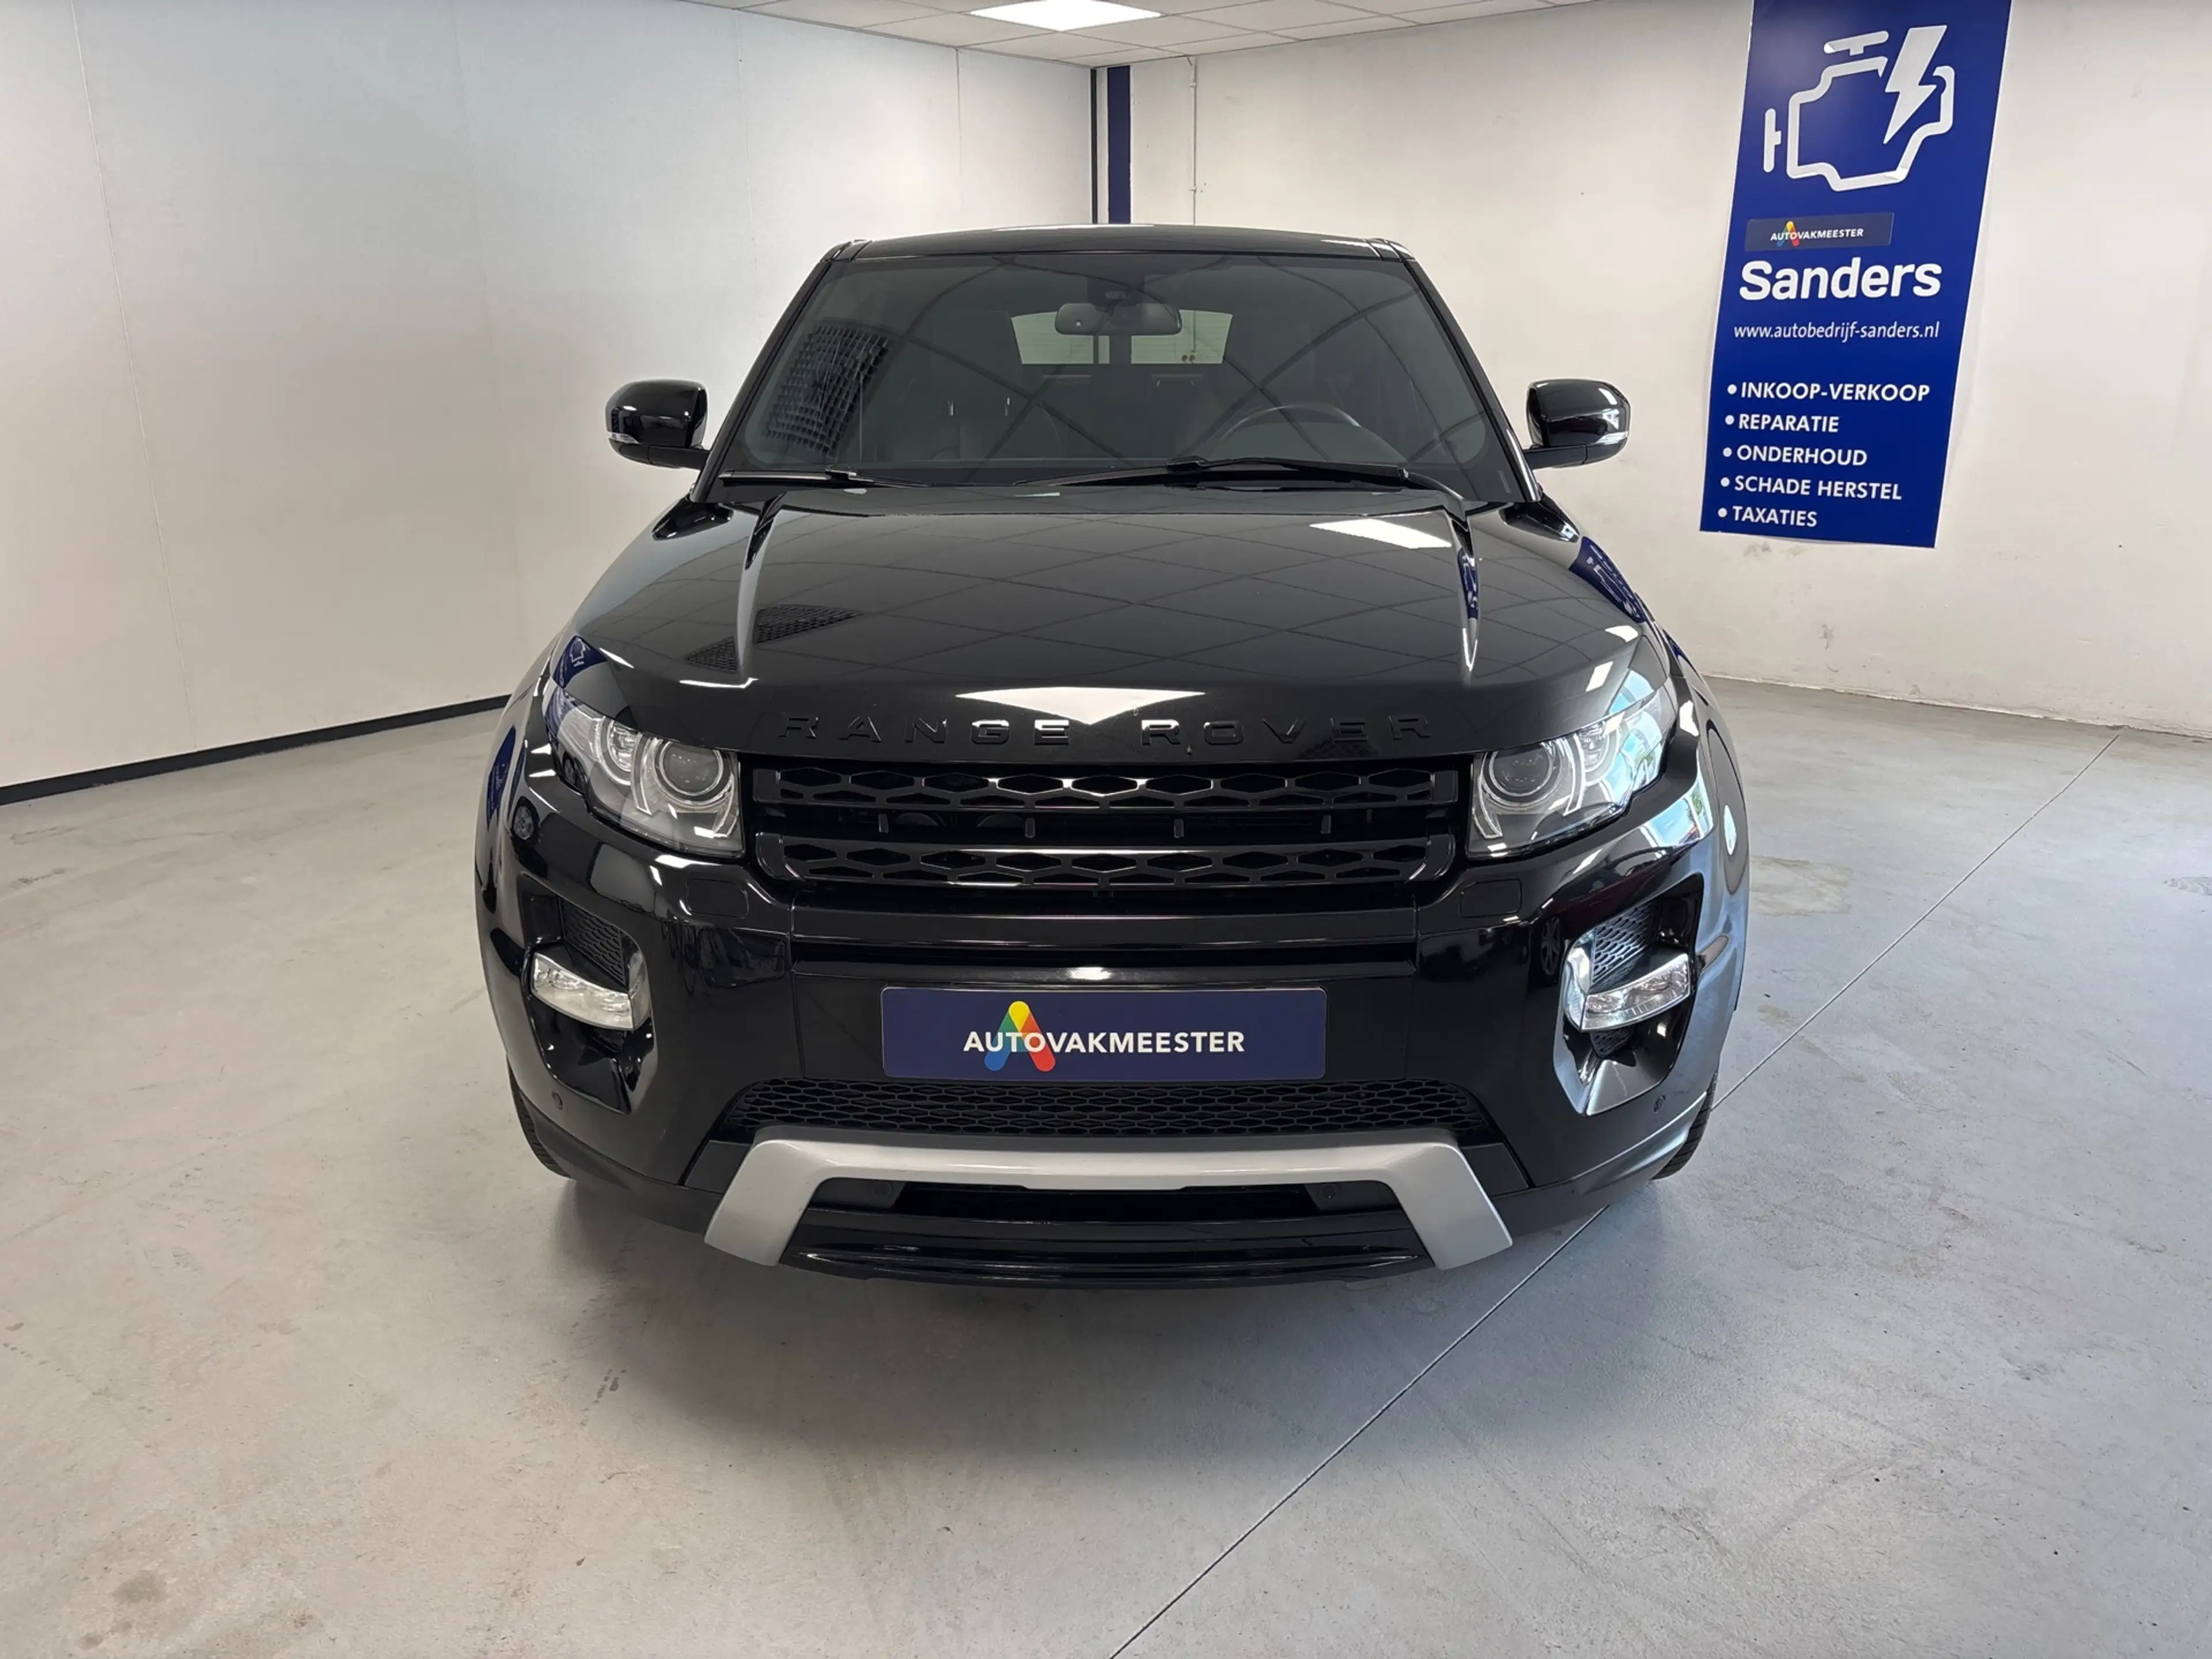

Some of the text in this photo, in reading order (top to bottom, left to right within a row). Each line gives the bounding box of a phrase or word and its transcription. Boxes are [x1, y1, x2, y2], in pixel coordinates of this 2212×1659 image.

[1770, 228, 1864, 241] AUTOVAKMEESTER
[1739, 257, 1942, 300] Sanders
[1734, 321, 1940, 343] www.autobedrijf-sanders.nl
[1741, 382, 1930, 402] INKOOP-VERKOOP
[1738, 414, 1839, 433] REPARATIE
[1737, 445, 1867, 465] ONDERHOUD
[1734, 475, 1902, 500] SCHADE HERSTEL
[1733, 506, 1817, 527] TAXATIES
[779, 714, 1431, 745] RANGE ROVER
[963, 1031, 1245, 1053] AUTOVAKMEESTER
